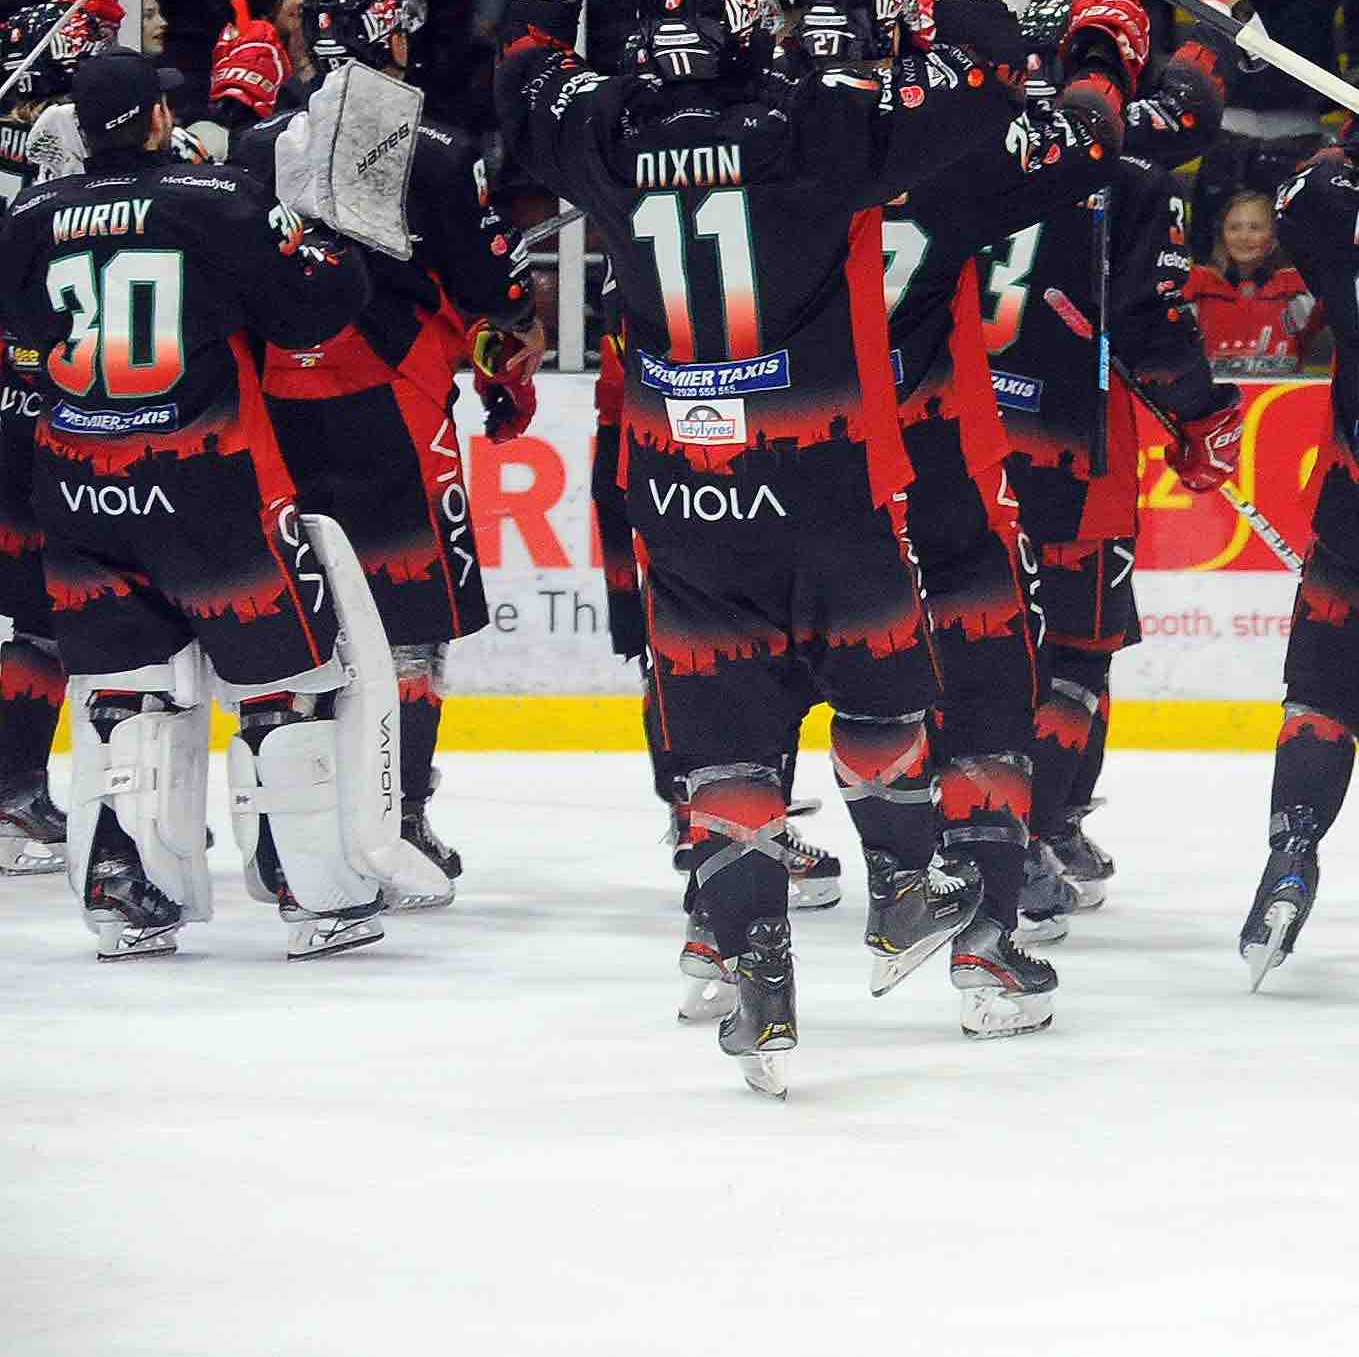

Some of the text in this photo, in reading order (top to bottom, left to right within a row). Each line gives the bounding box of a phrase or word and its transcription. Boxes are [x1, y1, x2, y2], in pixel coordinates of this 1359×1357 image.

[669, 50, 692, 76] 11
[813, 32, 840, 56] 27
[104, 105, 140, 131] CCM
[634, 144, 742, 189] DIXON
[52, 198, 153, 244] MURDY
[631, 186, 761, 362] 11
[46, 249, 186, 399] 30
[717, 358, 781, 386] TAXIS
[59, 480, 176, 517] VIOLA
[649, 478, 788, 522] VIOLA
[1140, 609, 1292, 639] ooth, stre
[379, 709, 394, 820] VAPOR
